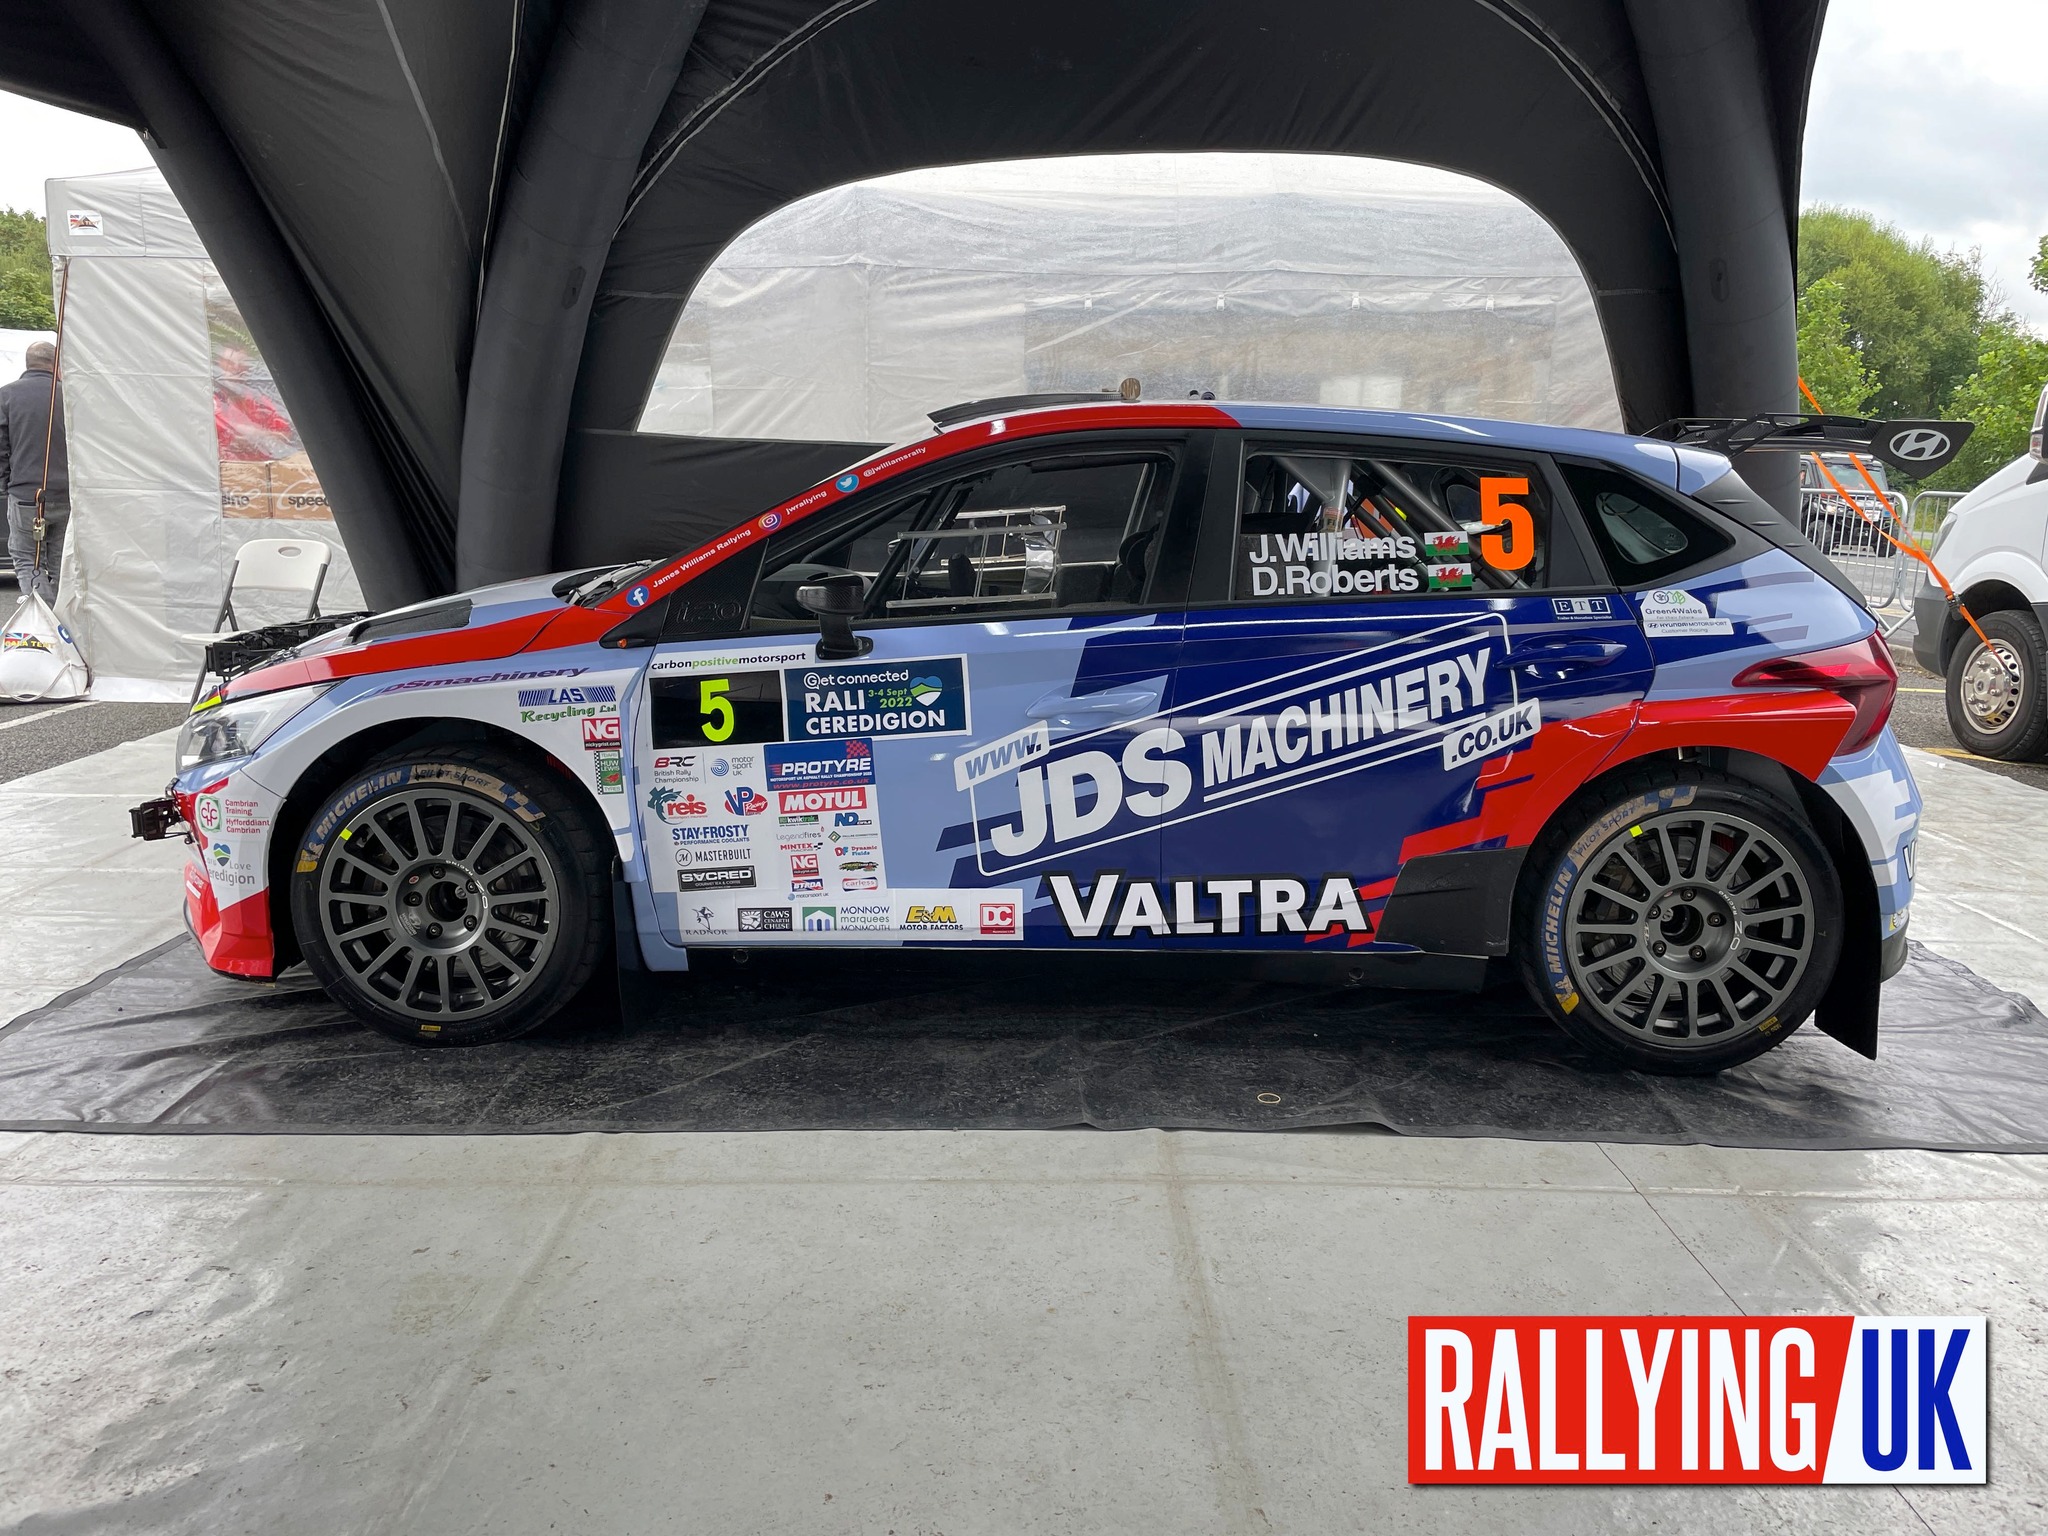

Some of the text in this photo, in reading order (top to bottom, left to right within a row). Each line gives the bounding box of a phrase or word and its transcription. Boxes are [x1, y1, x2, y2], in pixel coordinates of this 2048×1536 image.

[785, 490, 828, 515] jwrallying
[1480, 477, 1535, 571] 5
[1250, 532, 1417, 564] J.Williams
[653, 528, 752, 588] James Williams Rallying
[1252, 563, 1419, 596] D.Roberts
[651, 652, 806, 670] carbonpositivemotorsport
[837, 670, 909, 686] connected
[548, 688, 586, 705] LAS
[805, 690, 865, 713] RALI
[868, 687, 908, 698] 3-4 Sept
[700, 679, 735, 742] 5
[880, 697, 913, 709] 2022
[520, 704, 617, 723] Recycling Ltd
[805, 709, 945, 735] CEREDIGION
[583, 719, 620, 740] NG
[990, 647, 1490, 857] JDS MACHINERY
[654, 756, 696, 768] BRC
[732, 762, 753, 770] sport
[781, 757, 871, 776] PROTYRE
[655, 776, 699, 784] Championship
[773, 778, 870, 789] www.protyre.co.uk
[225, 799, 258, 807] Cambrian
[316, 770, 403, 841] MICHELIN
[667, 794, 707, 816] reis
[724, 786, 754, 816] VP
[784, 790, 863, 812] MOTUL
[225, 807, 253, 816] Training
[834, 812, 859, 827] ND
[226, 818, 270, 827] Hyfforddiant
[226, 826, 261, 834] Cambrian
[695, 848, 751, 862] MASTERBUILT
[791, 855, 817, 869] NG
[229, 860, 251, 871] Love
[763, 910, 790, 918] CAWS
[840, 906, 890, 914] MONNOW
[905, 905, 957, 923] E&M
[1048, 873, 1369, 937] VALTRA
[840, 915, 890, 925] marquees
[982, 906, 1013, 927] DC
[1545, 867, 1573, 974] MICHELIN
[840, 924, 890, 932] MONMOUTH
